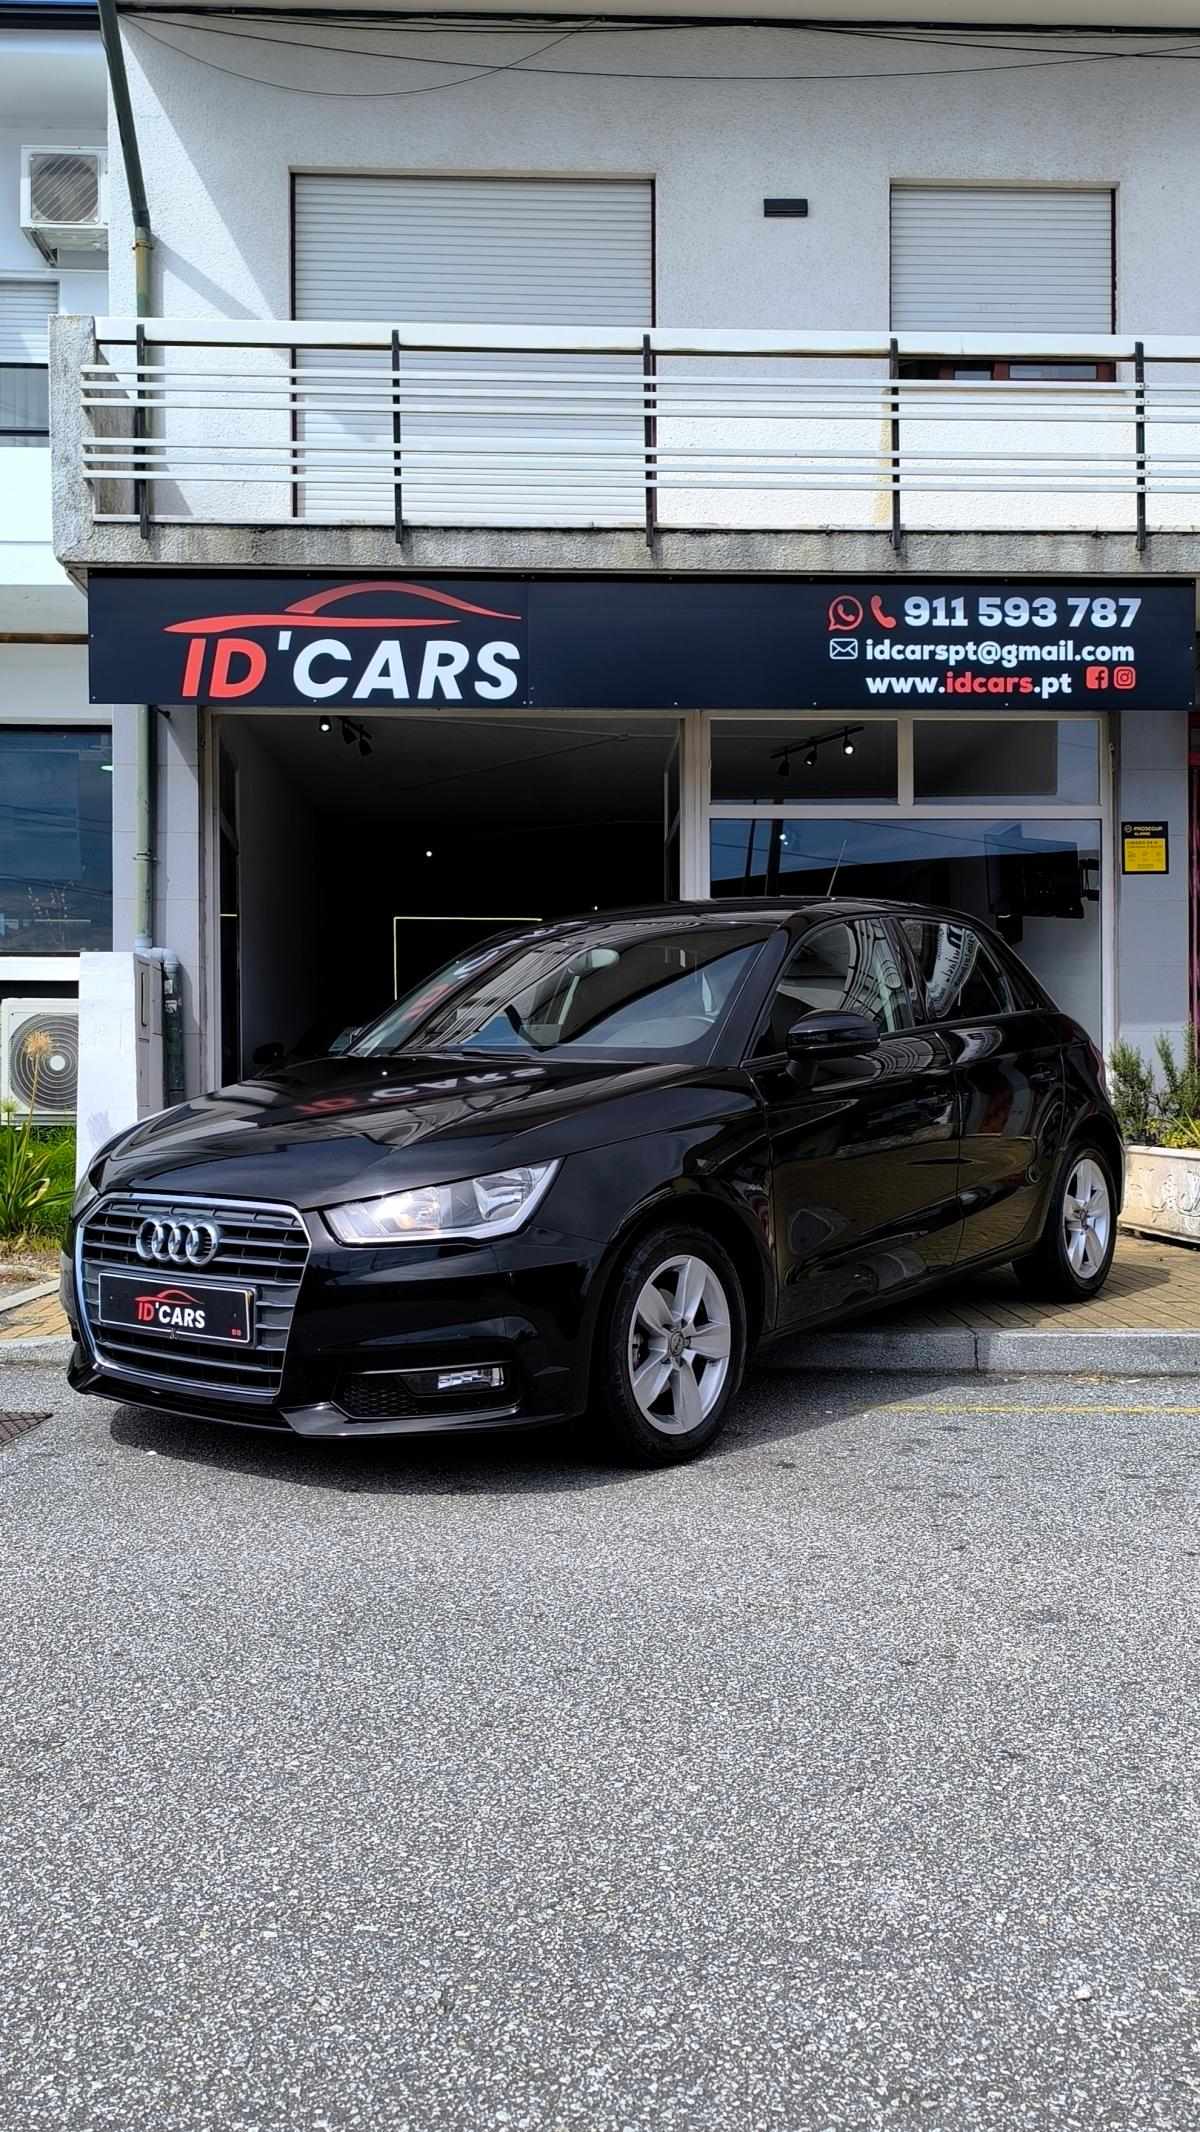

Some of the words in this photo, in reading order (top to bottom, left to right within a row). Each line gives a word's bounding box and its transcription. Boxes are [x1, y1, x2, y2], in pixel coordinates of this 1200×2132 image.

[903, 595, 969, 628] 911
[977, 595, 1058, 628] 593
[1067, 596, 1142, 629] 787
[181, 630, 522, 701] ID'CARS
[865, 638, 1136, 668] idcarspt@gmail.com
[865, 671, 1073, 699] www.idcars.pt
[136, 1301, 206, 1329] ID'CARS
